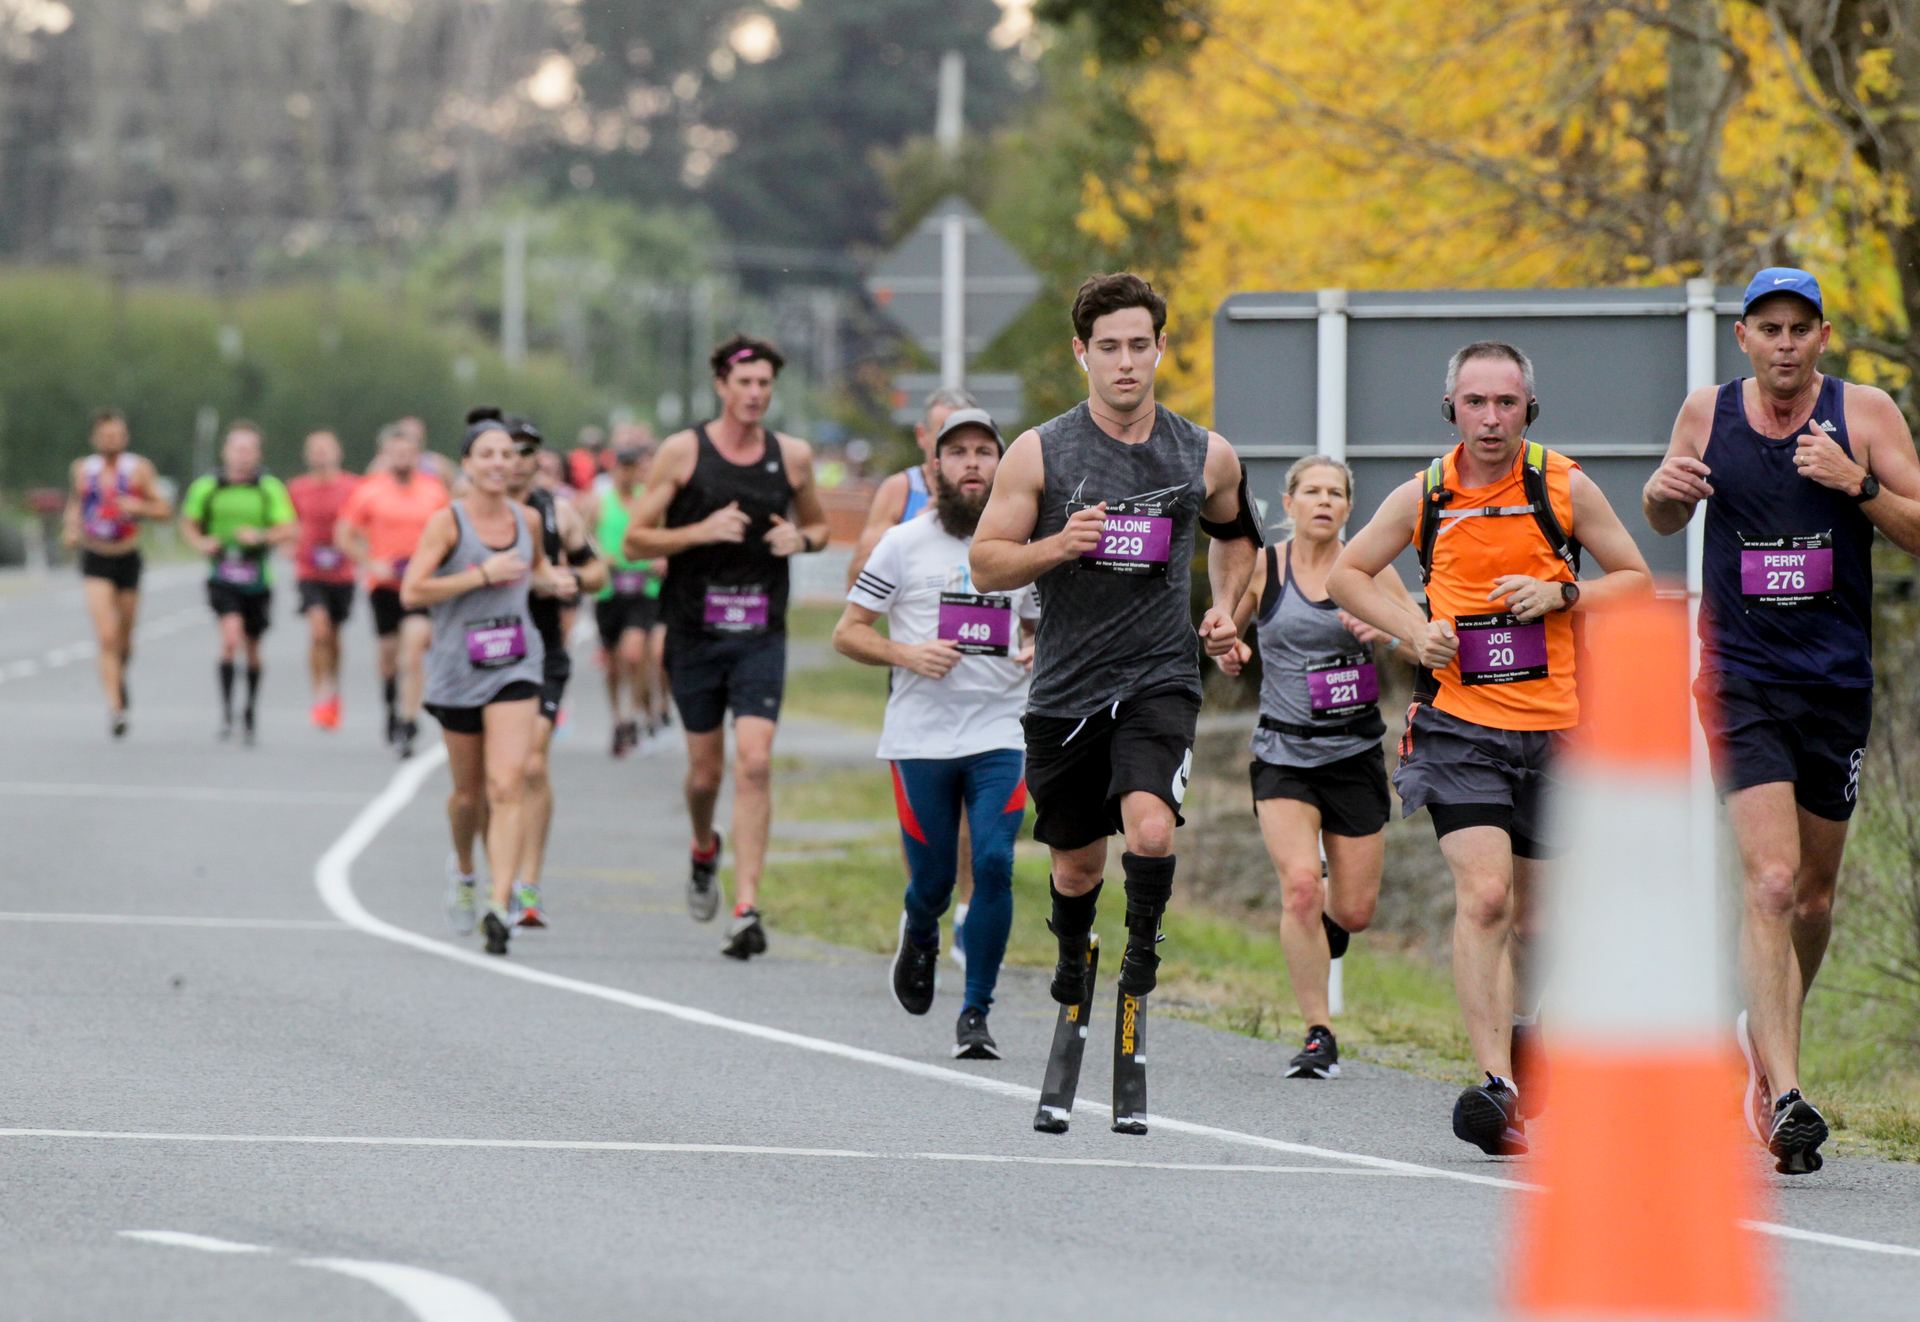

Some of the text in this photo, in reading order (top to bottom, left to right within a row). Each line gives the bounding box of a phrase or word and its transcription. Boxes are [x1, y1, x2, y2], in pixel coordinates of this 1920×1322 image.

[1099, 519, 1151, 533] MALONE
[1104, 535, 1143, 556] 229
[1764, 554, 1806, 567] PERRY
[1766, 570, 1805, 590] 276
[958, 622, 991, 642] 449
[1487, 632, 1512, 645] JOE
[1488, 648, 1514, 666] 20
[1326, 670, 1360, 685] GREER
[1330, 684, 1358, 704] 221
